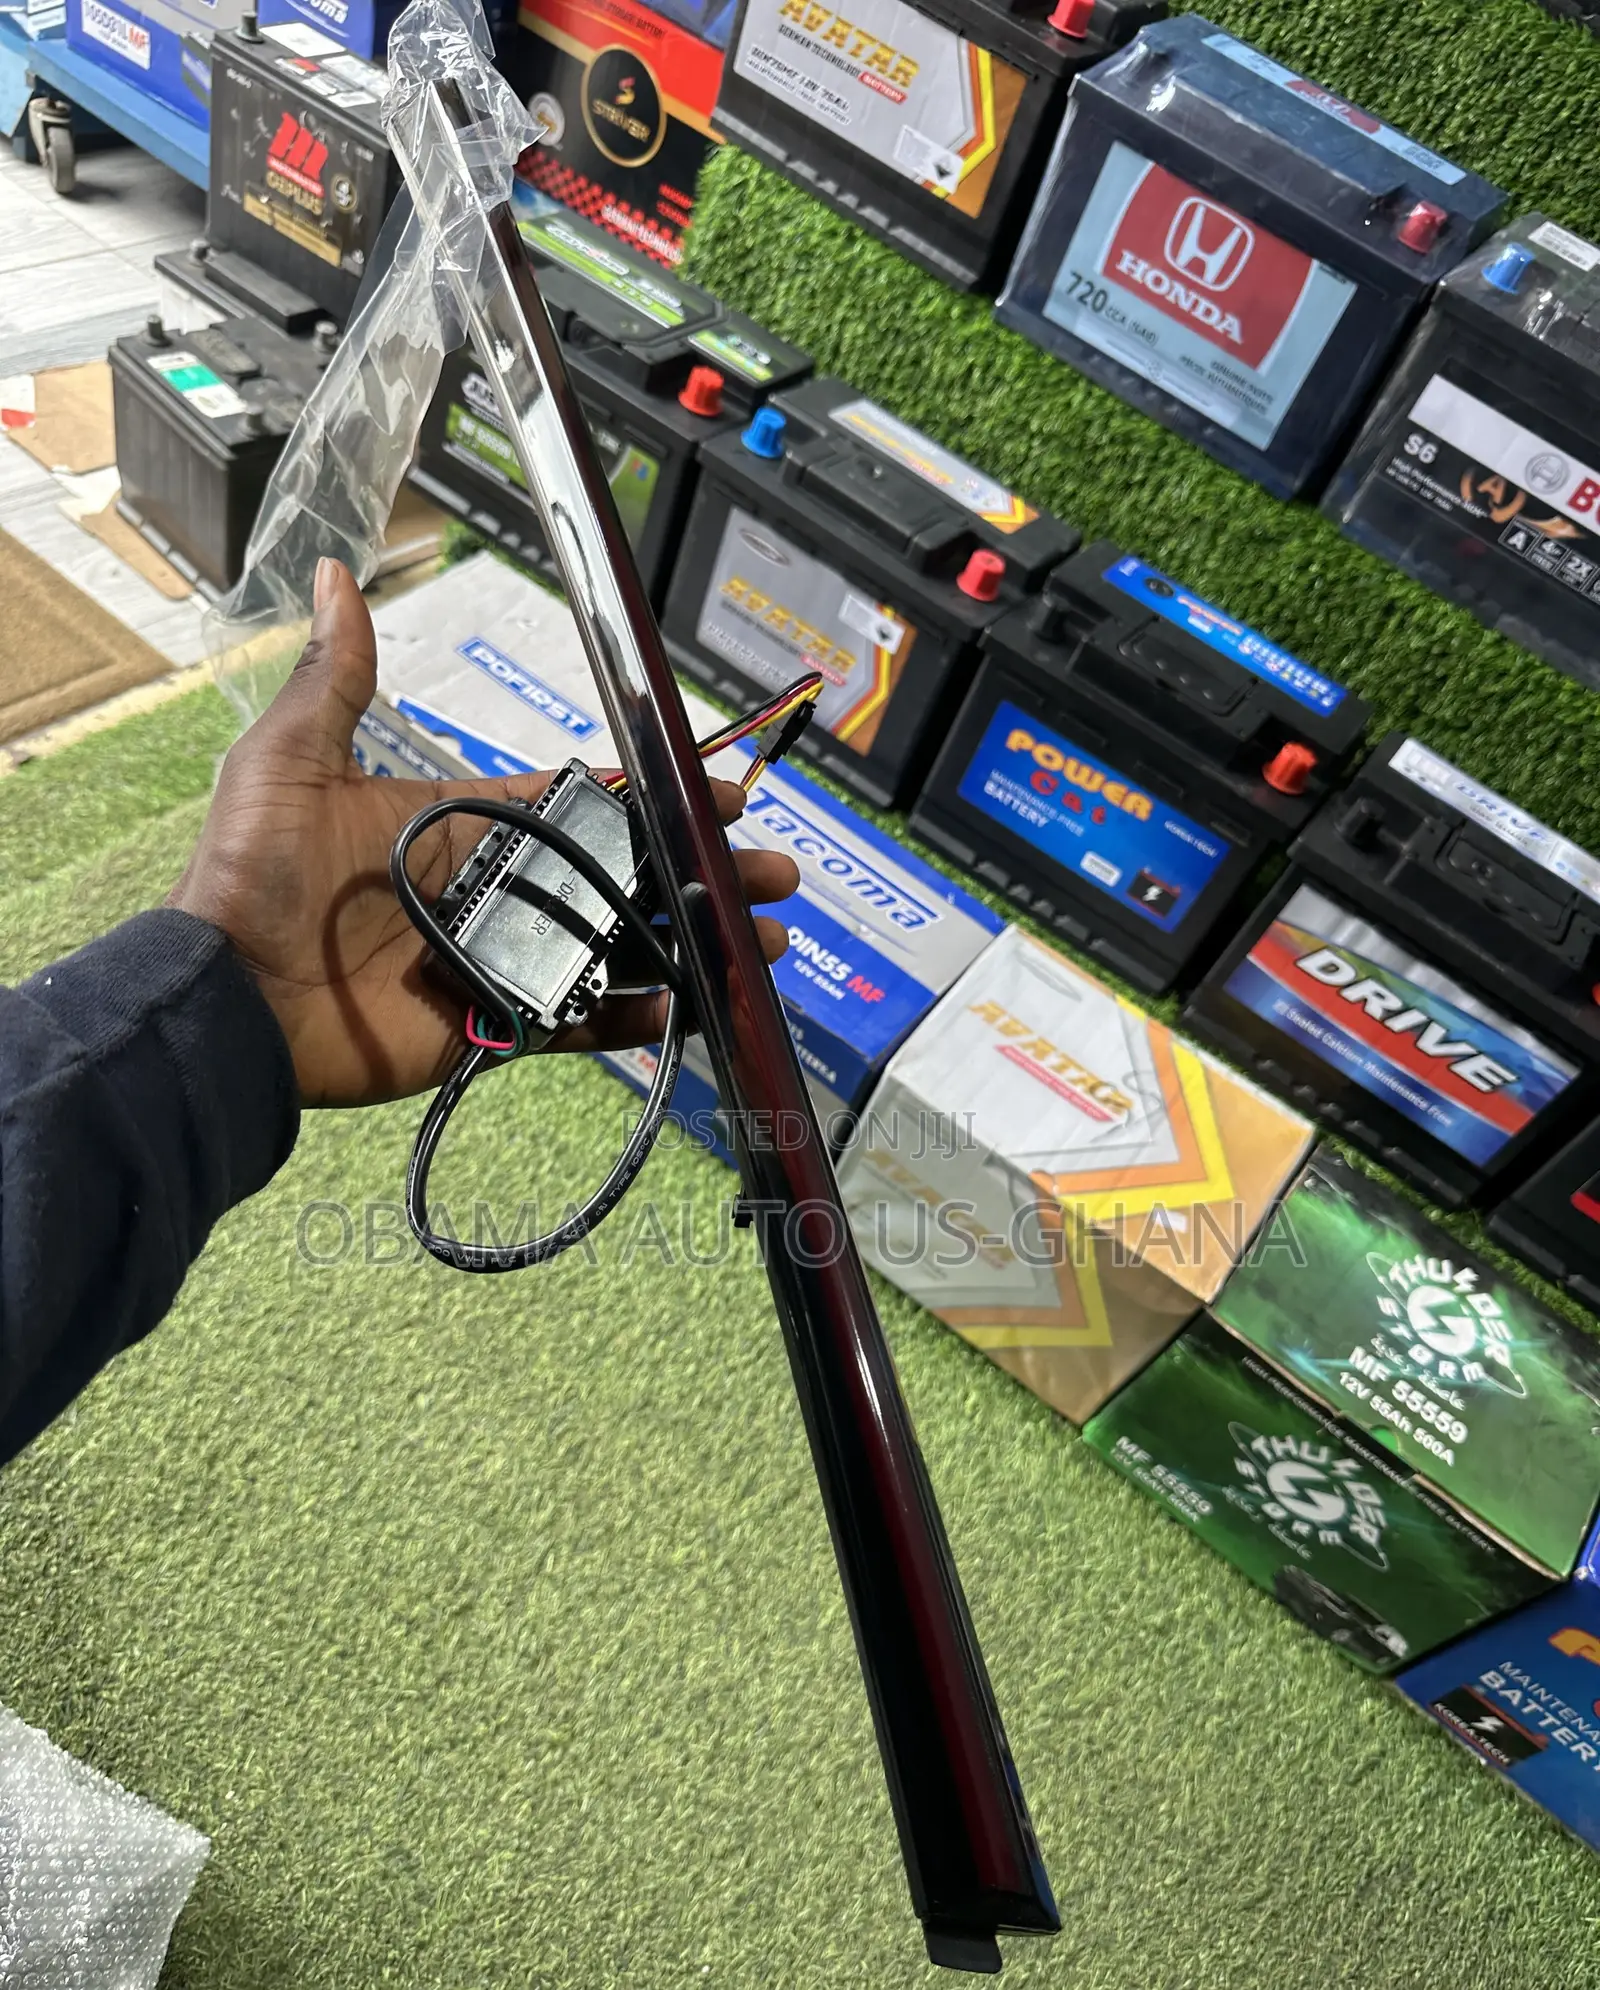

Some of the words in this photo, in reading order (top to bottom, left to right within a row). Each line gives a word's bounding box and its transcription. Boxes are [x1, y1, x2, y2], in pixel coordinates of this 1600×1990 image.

[778, 0, 919, 88] AVATAR
[1066, 270, 1108, 314] 720
[1115, 248, 1244, 345] HONDA
[1403, 432, 1438, 464] S6
[719, 576, 857, 674] AVATAR
[984, 779, 1050, 829] BATTERY
[1005, 728, 1153, 822] POWER
[747, 787, 938, 932] Tacoma
[787, 925, 852, 981] DIN55
[846, 975, 885, 1003] MF
[1294, 945, 1521, 1094] DRIVE
[609, 1169, 632, 1199] TYPE
[1241, 1354, 1268, 1384] HIGH
[1264, 1370, 1344, 1439] PERFORMANCE
[1343, 1433, 1416, 1493] MAINTENANCE
[1339, 1371, 1372, 1399] 12V
[1369, 1395, 1413, 1435] 55Ah
[1412, 1427, 1455, 1467] 500A
[1349, 1346, 1392, 1382] MF
[1391, 1379, 1468, 1444] 55559
[1115, 1434, 1152, 1464] MF
[1150, 1463, 1213, 1516] 55559
[1433, 1702, 1477, 1739] KOREA
[1477, 1735, 1511, 1764] TECH
[1499, 1661, 1600, 1746] MAINTENA
